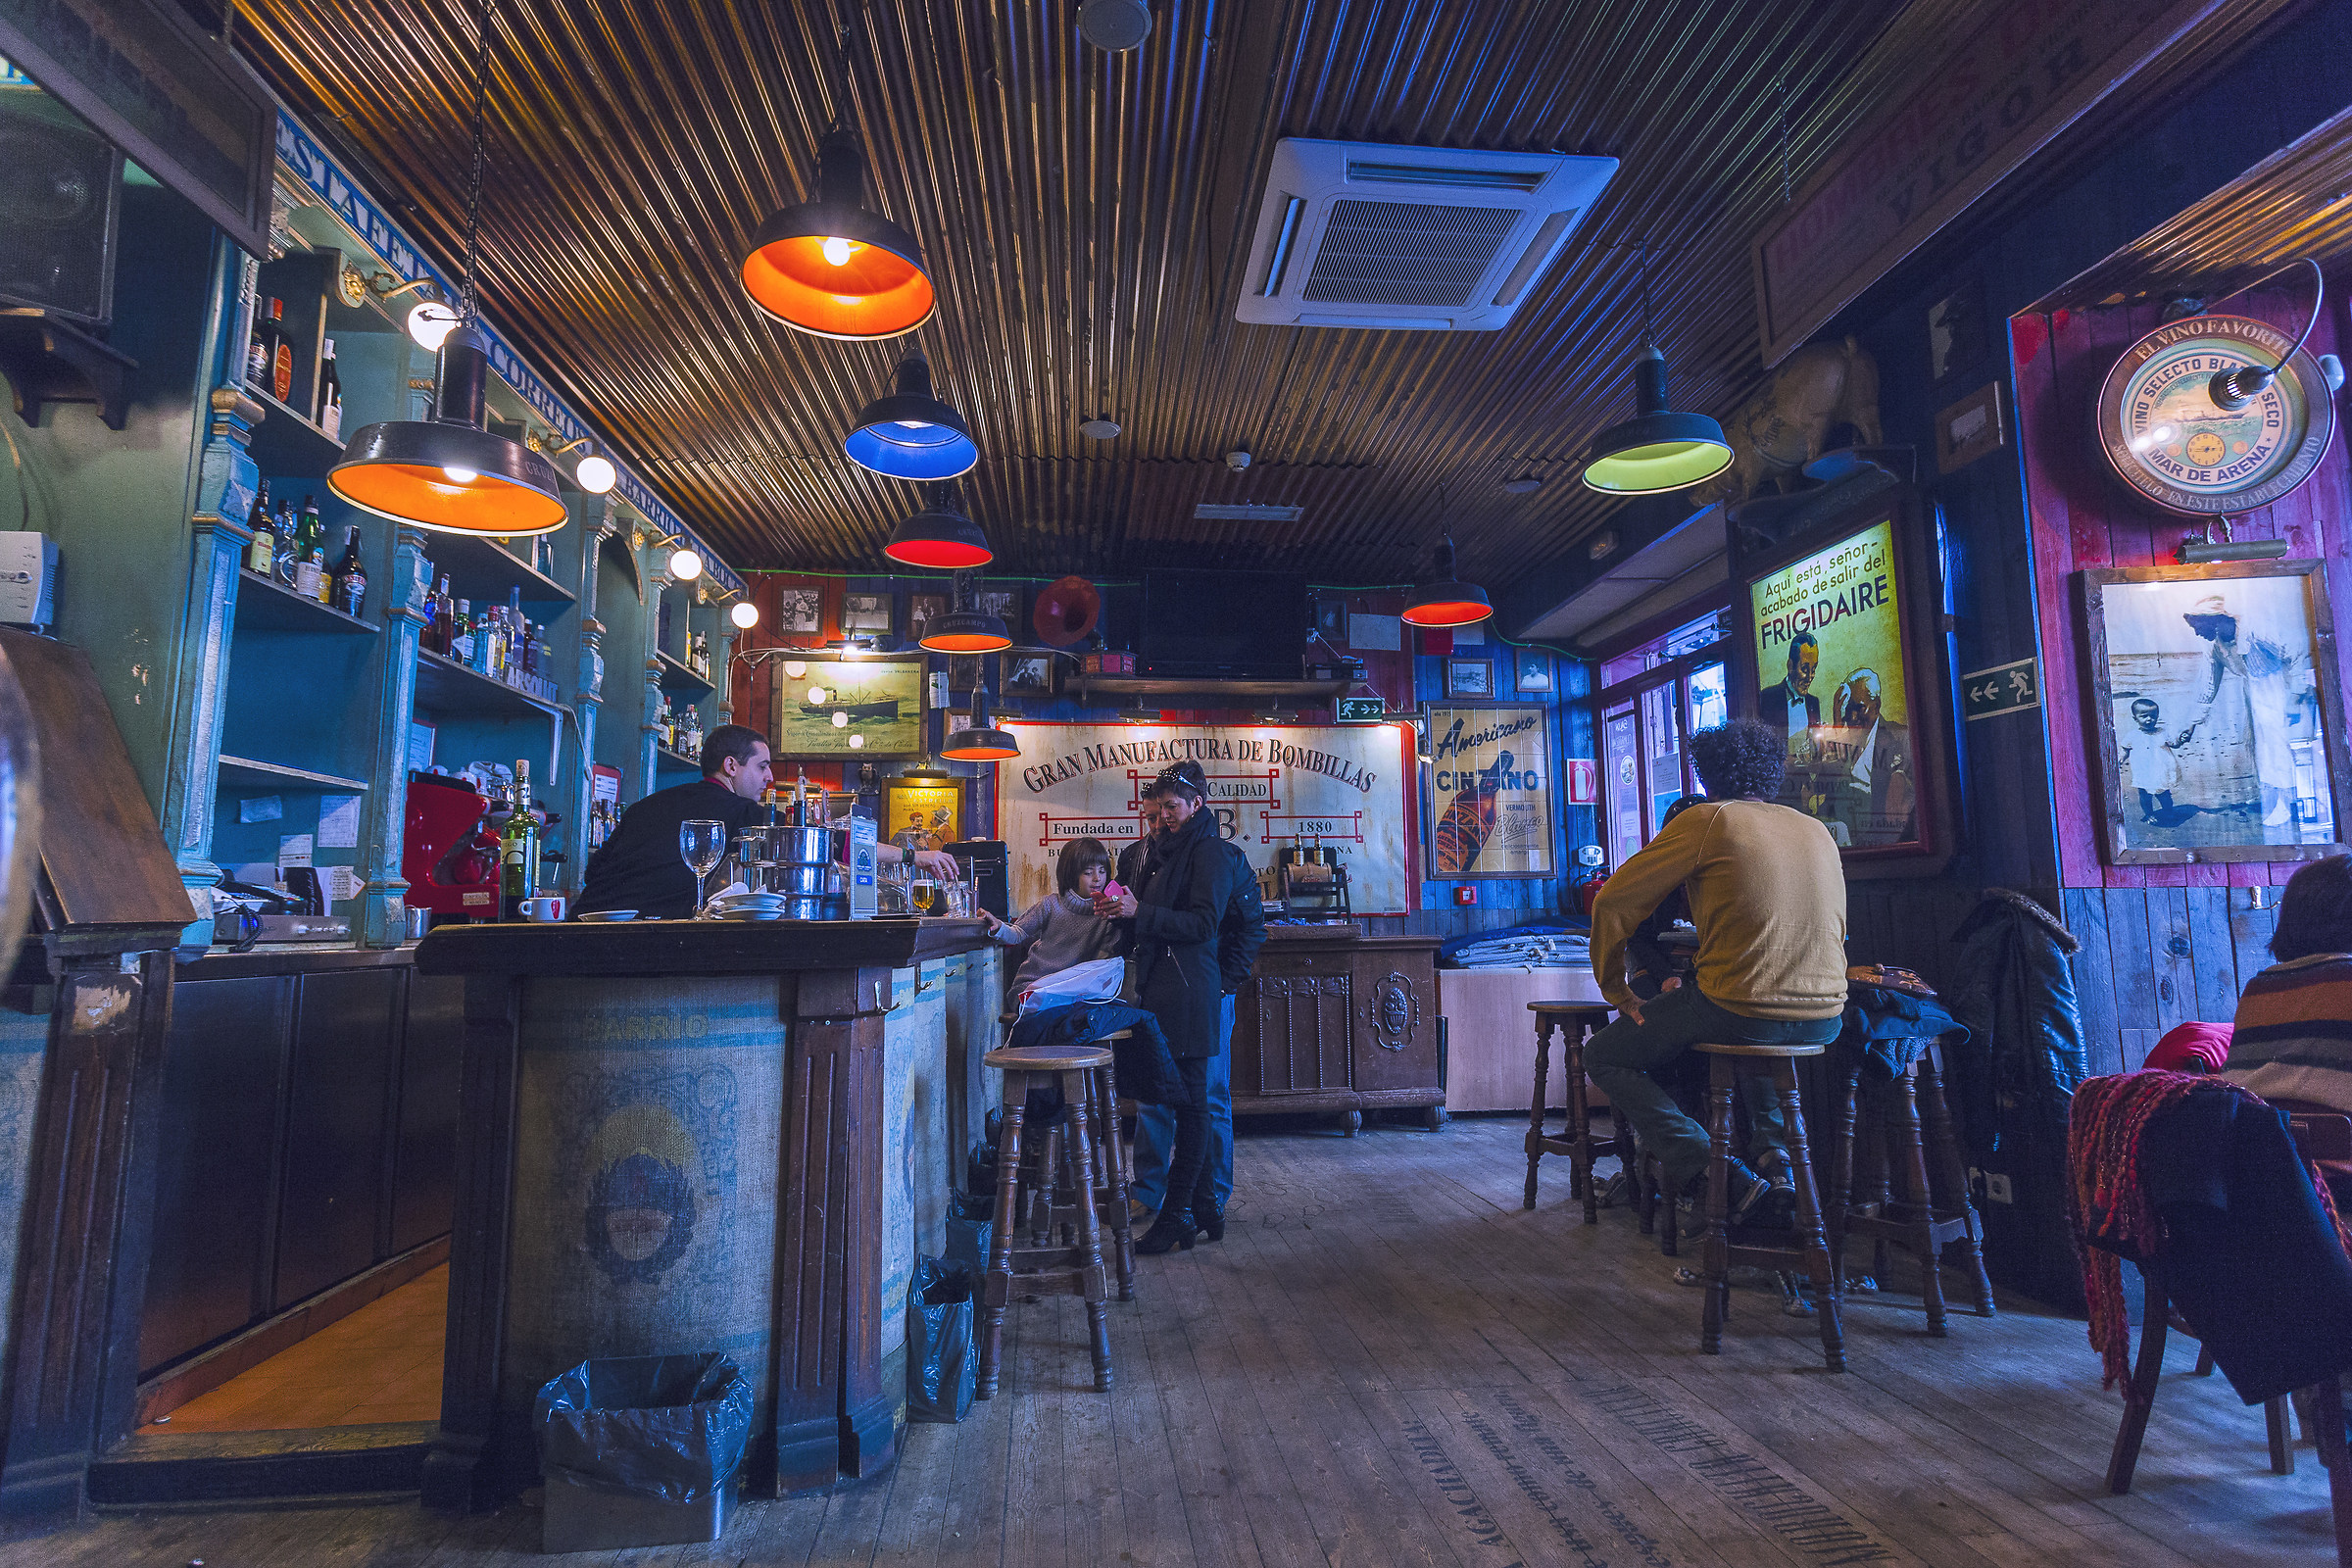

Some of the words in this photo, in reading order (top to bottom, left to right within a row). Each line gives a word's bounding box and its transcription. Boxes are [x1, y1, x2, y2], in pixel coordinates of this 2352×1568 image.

[1887, 36, 2087, 225] VIGOR
[2134, 342, 2161, 361] EL
[2156, 321, 2203, 345] VINO
[490, 340, 591, 455] CORREOS
[2143, 359, 2201, 398] SELECTO
[2261, 392, 2279, 428] SECO
[2148, 449, 2183, 477] MAR
[2187, 469, 2211, 482] DE
[2217, 445, 2272, 481] ARENA
[2167, 491, 2185, 505] EN
[2186, 495, 2219, 510] ESTE
[1760, 587, 1809, 616] acabado
[1812, 579, 1828, 594] de
[1831, 565, 1859, 588] salir
[1863, 549, 1886, 572] del
[943, 618, 986, 629] CRUZCAMPO
[1760, 573, 1889, 650] FRIGIDAIRE
[1437, 715, 1538, 760] Americano
[1023, 753, 1085, 793] GRAN
[1083, 738, 1235, 773] MANUFACTURA
[1238, 739, 1263, 762] DE
[1267, 738, 1378, 794] BOMBILLAS
[1436, 769, 1539, 792] CINZANO
[907, 789, 955, 799] VICTORIA
[1207, 781, 1267, 797] CALIDAD
[1054, 823, 1114, 835] Fundada
[1118, 825, 1134, 834] en
[1298, 821, 1333, 833] 1880
[1494, 813, 1544, 840] Blanco
[1586, 1500, 1679, 1568] espues
